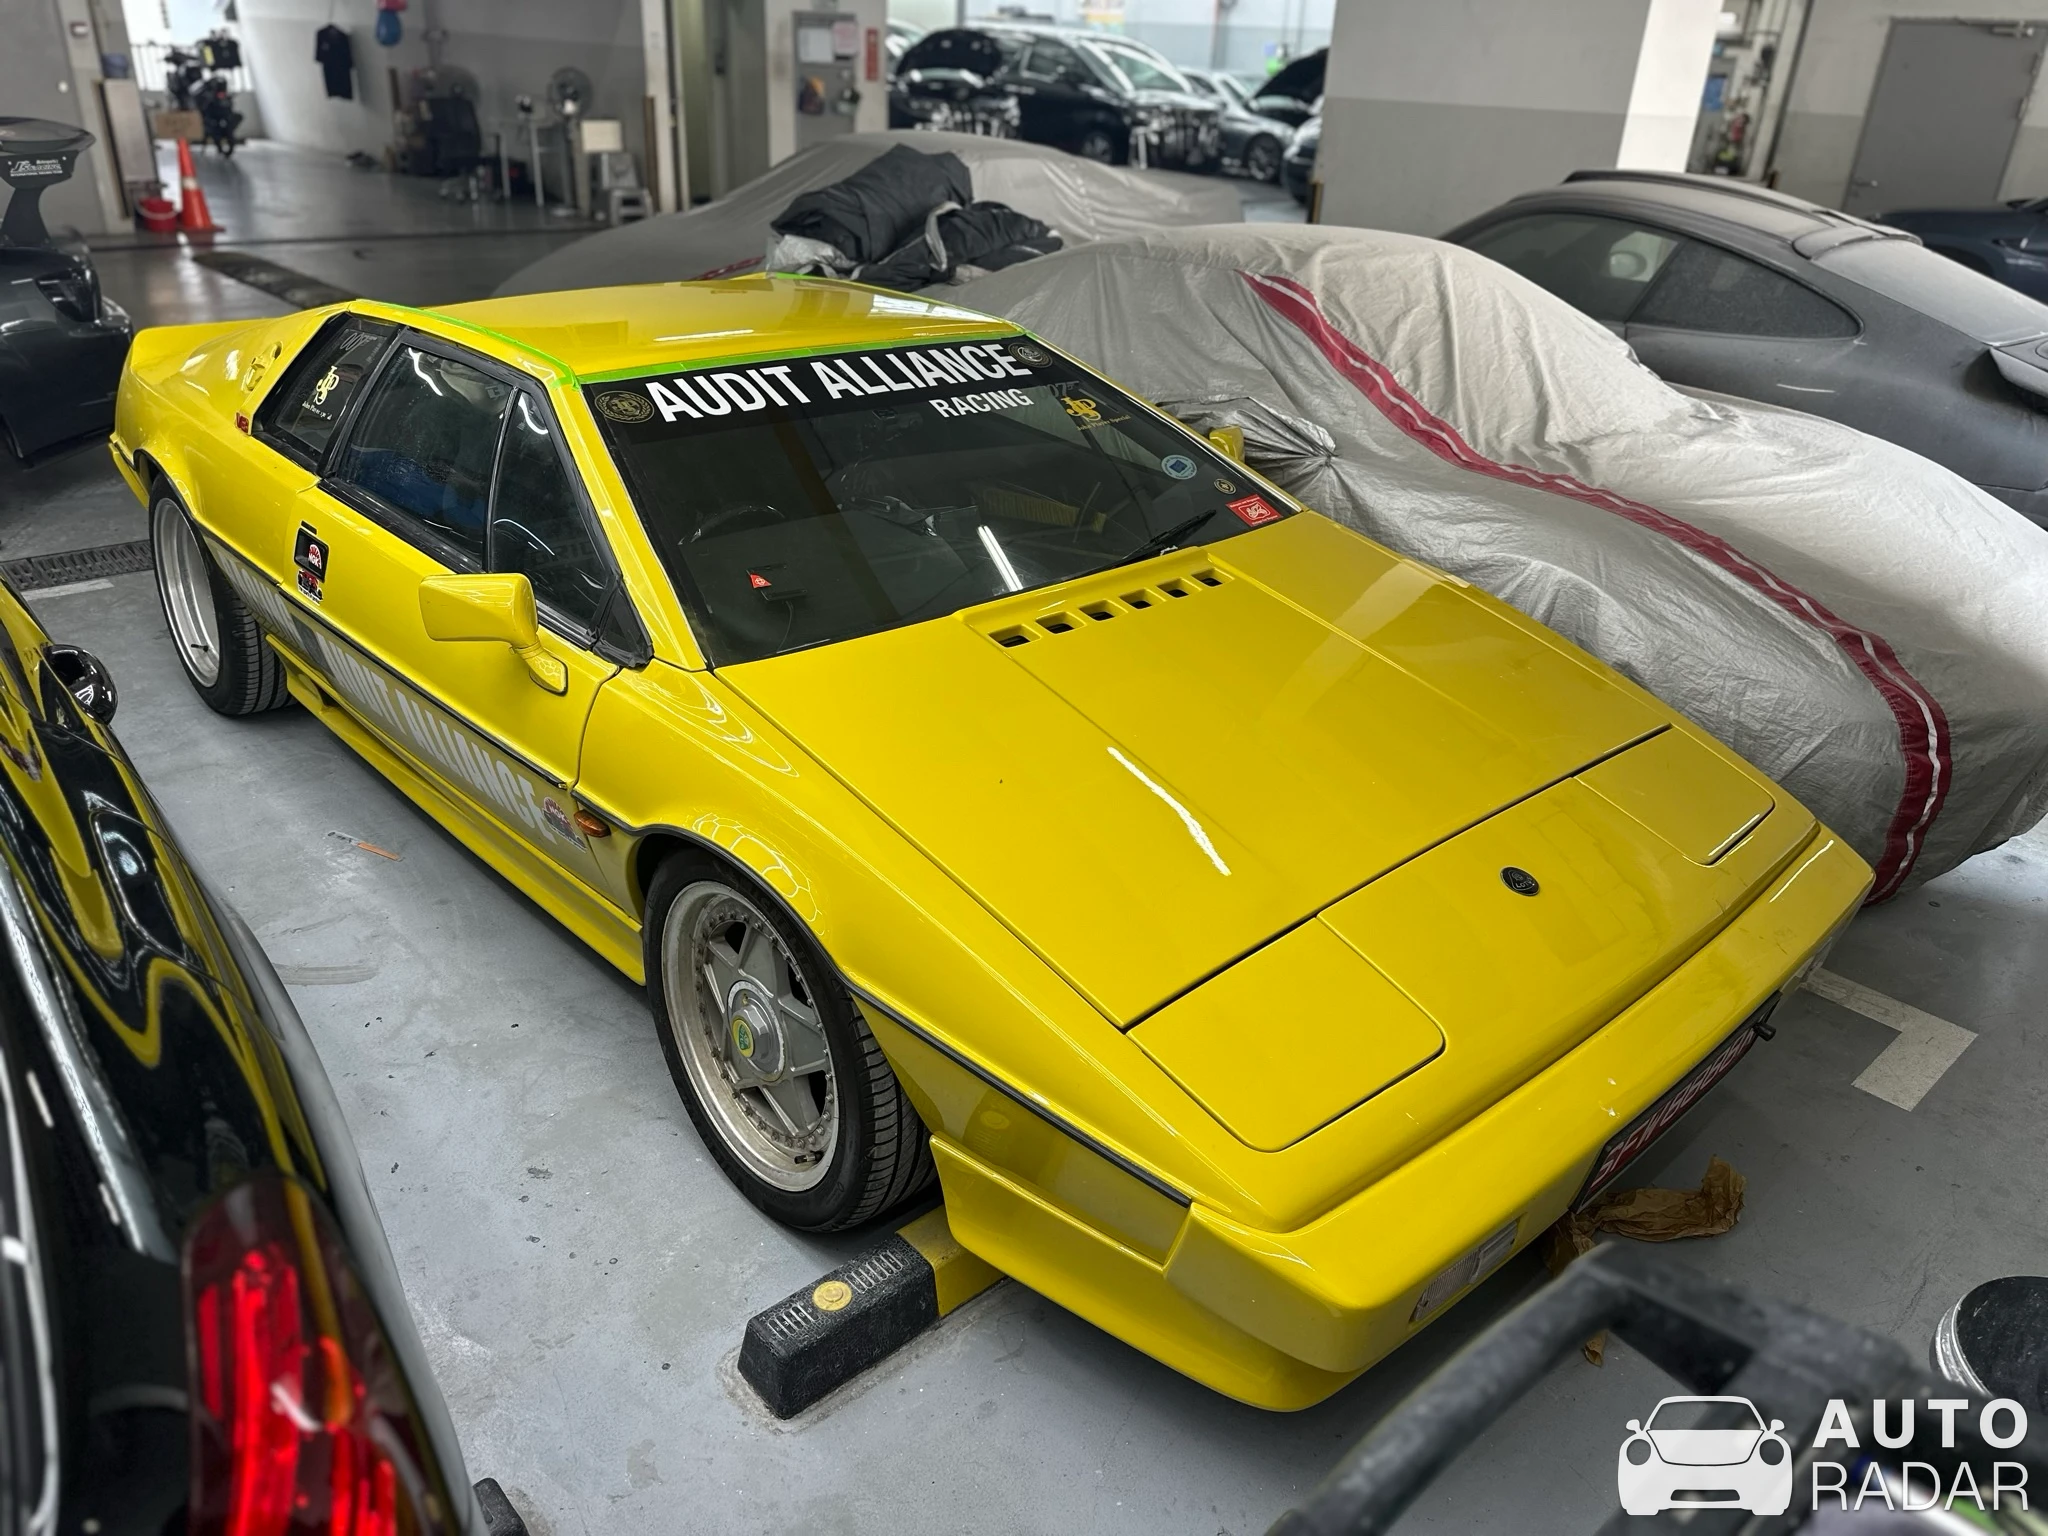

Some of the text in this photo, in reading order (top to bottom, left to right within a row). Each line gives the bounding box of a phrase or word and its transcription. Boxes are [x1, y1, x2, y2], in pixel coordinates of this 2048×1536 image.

[645, 365, 811, 422] AUDIT
[810, 344, 1033, 399] ALLIANCE
[928, 389, 1034, 418] RACING
[395, 688, 557, 845] ALLIANCE
